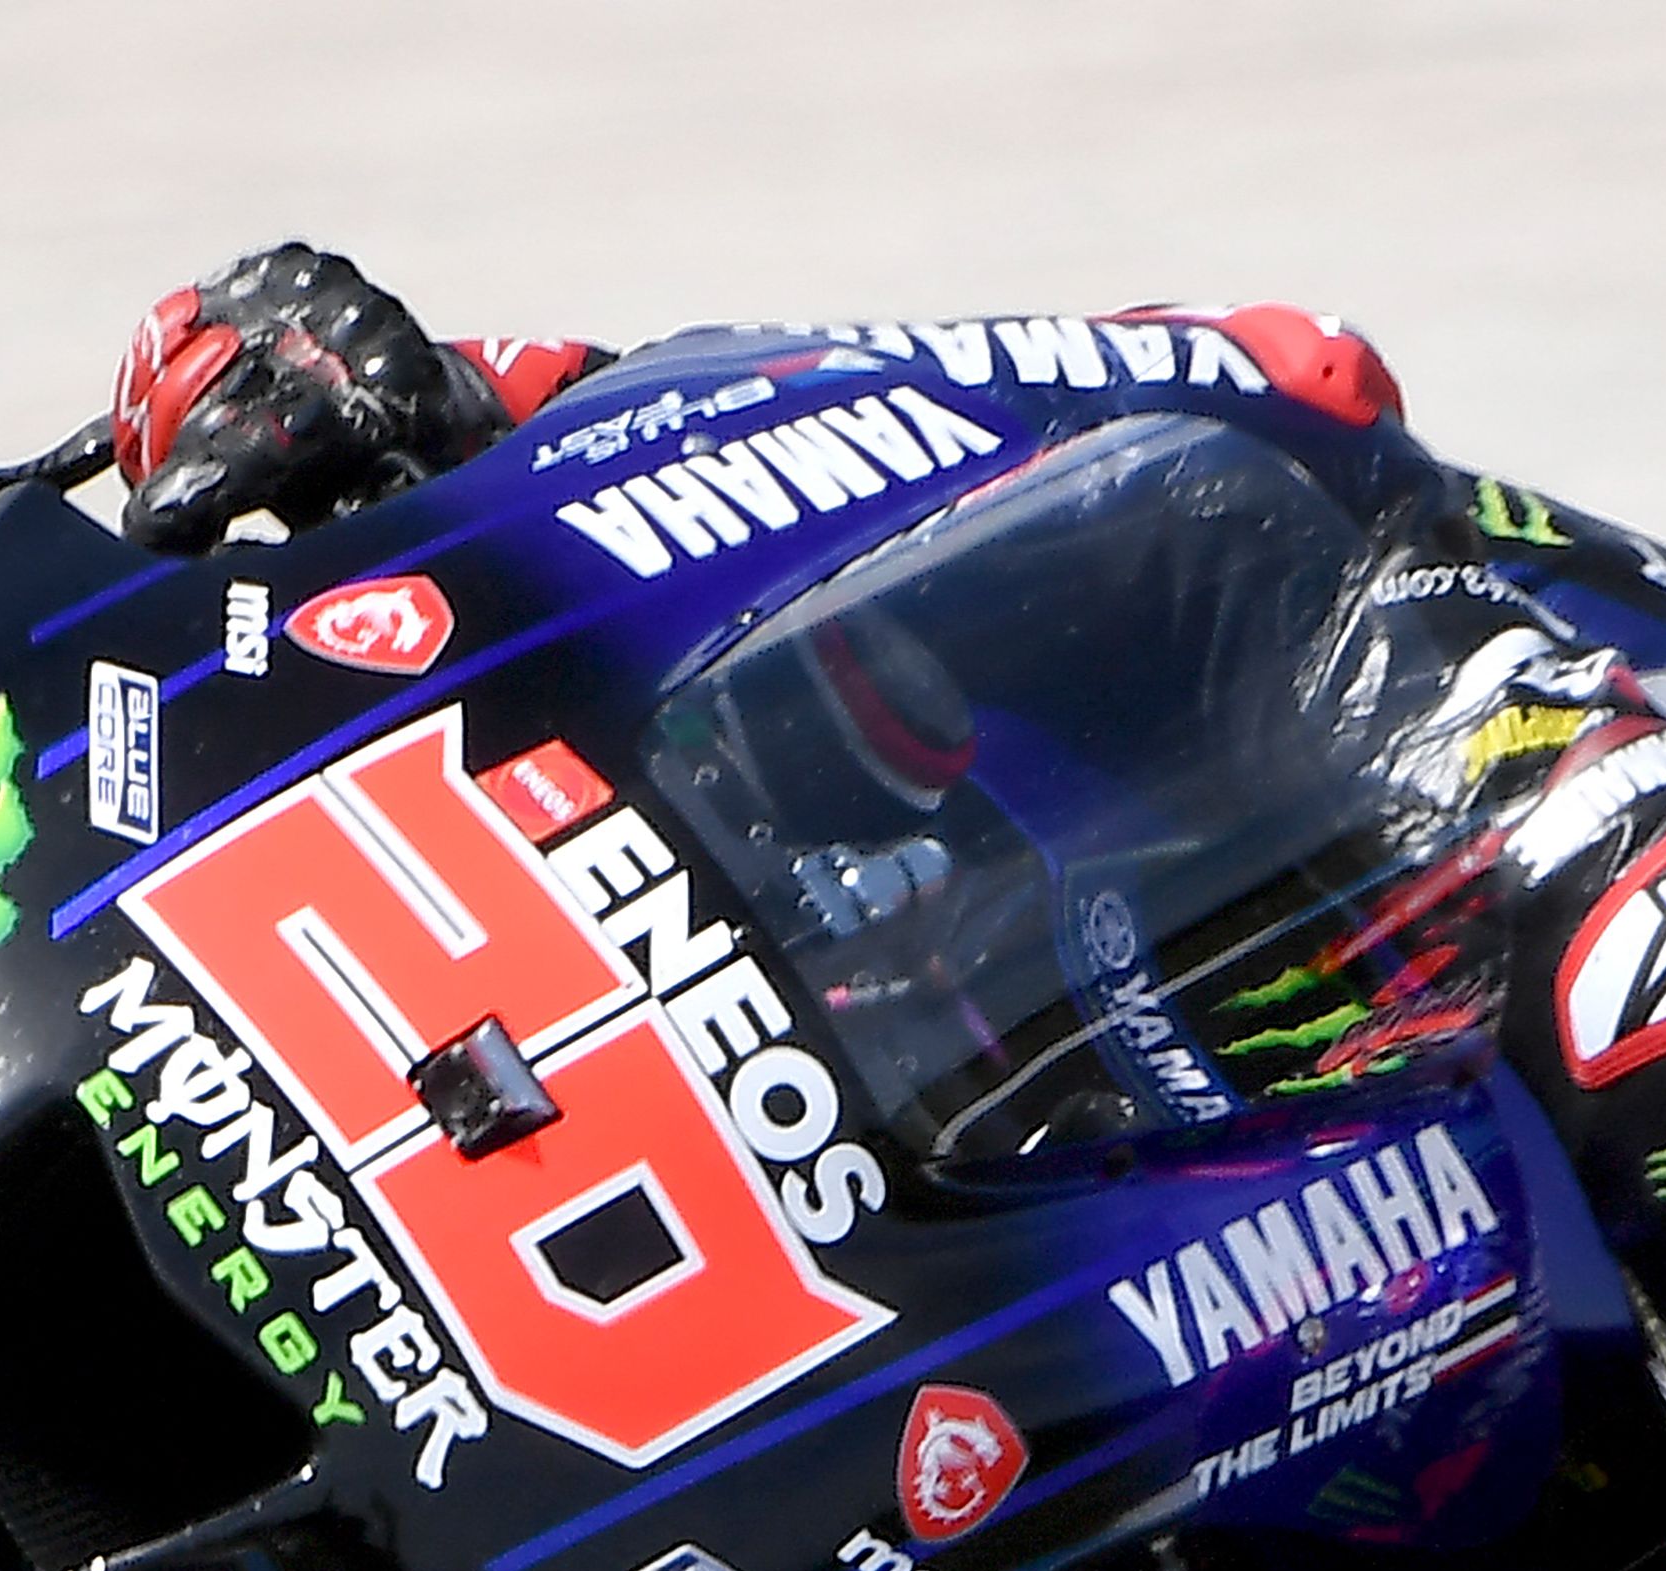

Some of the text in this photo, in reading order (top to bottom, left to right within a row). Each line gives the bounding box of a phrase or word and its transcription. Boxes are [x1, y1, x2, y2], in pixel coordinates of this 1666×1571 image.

[554, 384, 1005, 580] YAMAHA
[226, 578, 271, 678] msi
[96, 683, 117, 808] CORE
[125, 686, 154, 821] BLUE
[549, 806, 886, 1245] ENEOS
[1112, 971, 1233, 1124] YAMA
[75, 1068, 366, 1428] ENERGY
[80, 957, 489, 1488] MONSTER
[1107, 1124, 1499, 1389] YAMAHA
[1191, 1355, 1435, 1500] THE LIMITS
[1290, 1300, 1464, 1415] BEYOND
